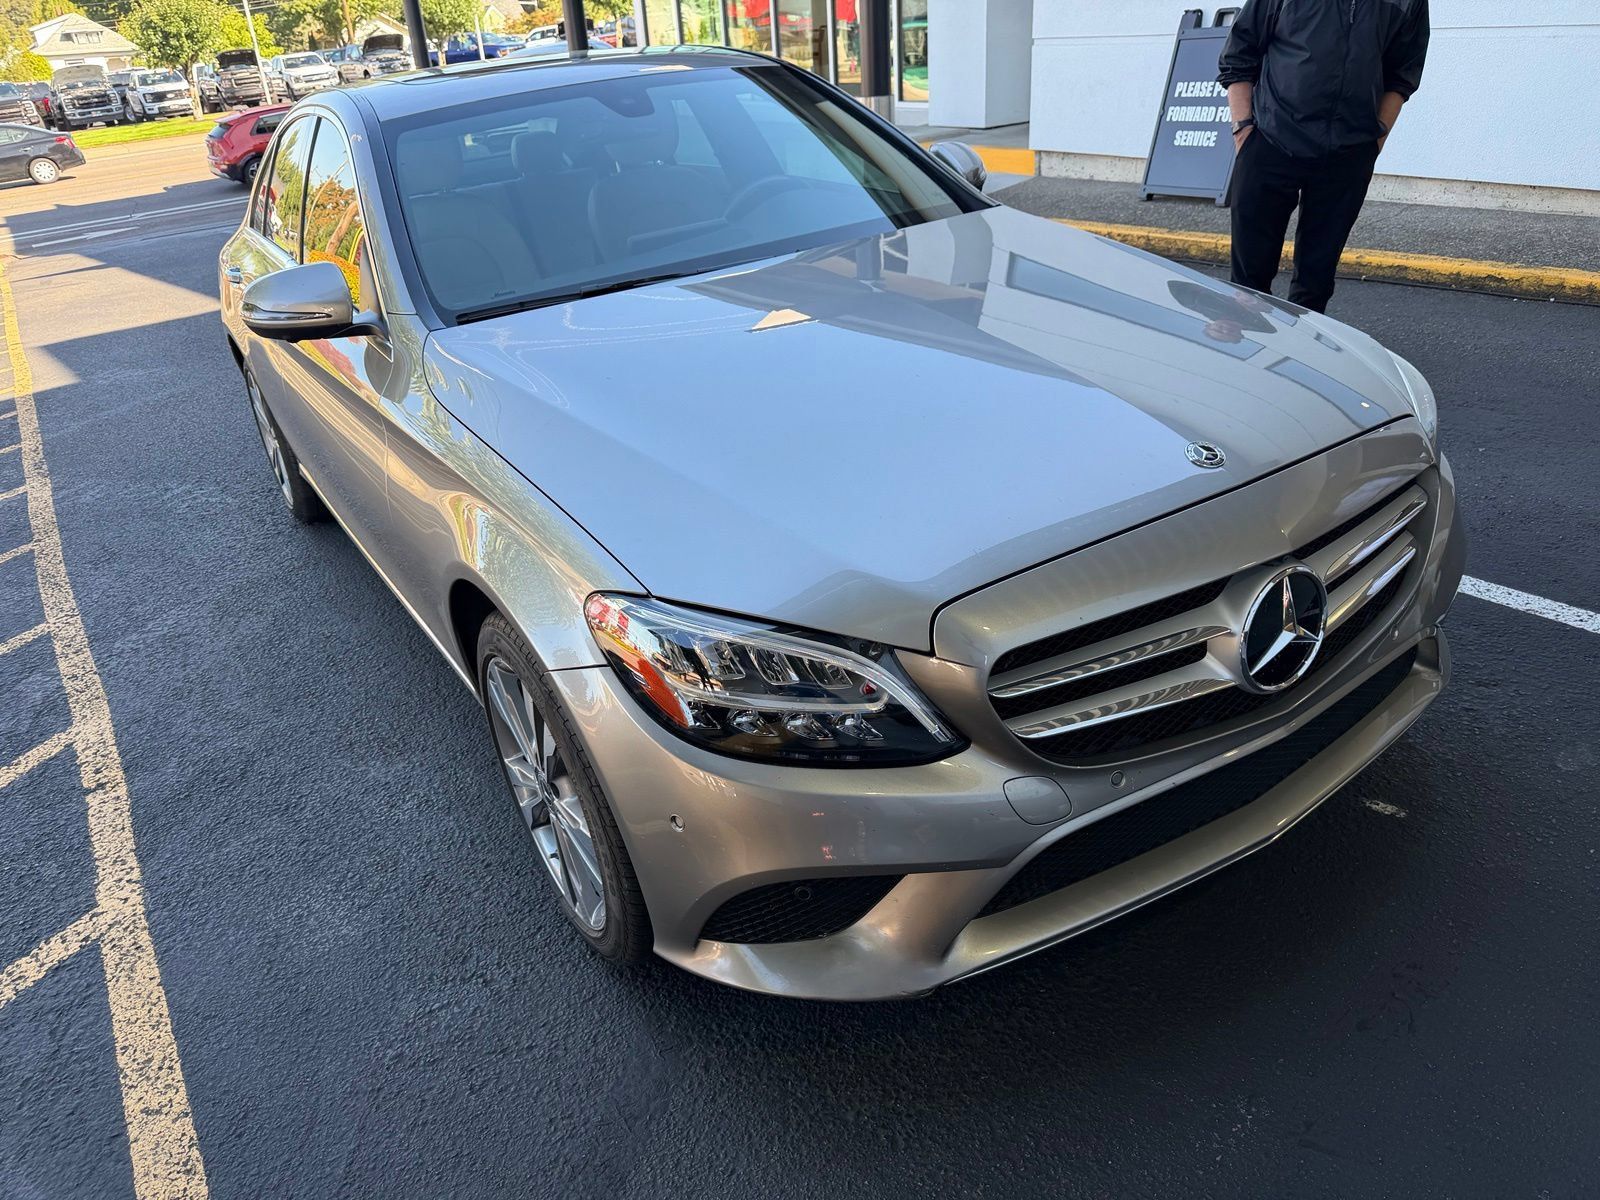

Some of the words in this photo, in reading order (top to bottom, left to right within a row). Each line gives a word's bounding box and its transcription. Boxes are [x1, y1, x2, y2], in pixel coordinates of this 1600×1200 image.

[1174, 81, 1214, 97] PLEASE
[1166, 105, 1216, 122] FORWARD
[1215, 105, 1232, 122] FO
[1173, 130, 1217, 146] SERVICE
